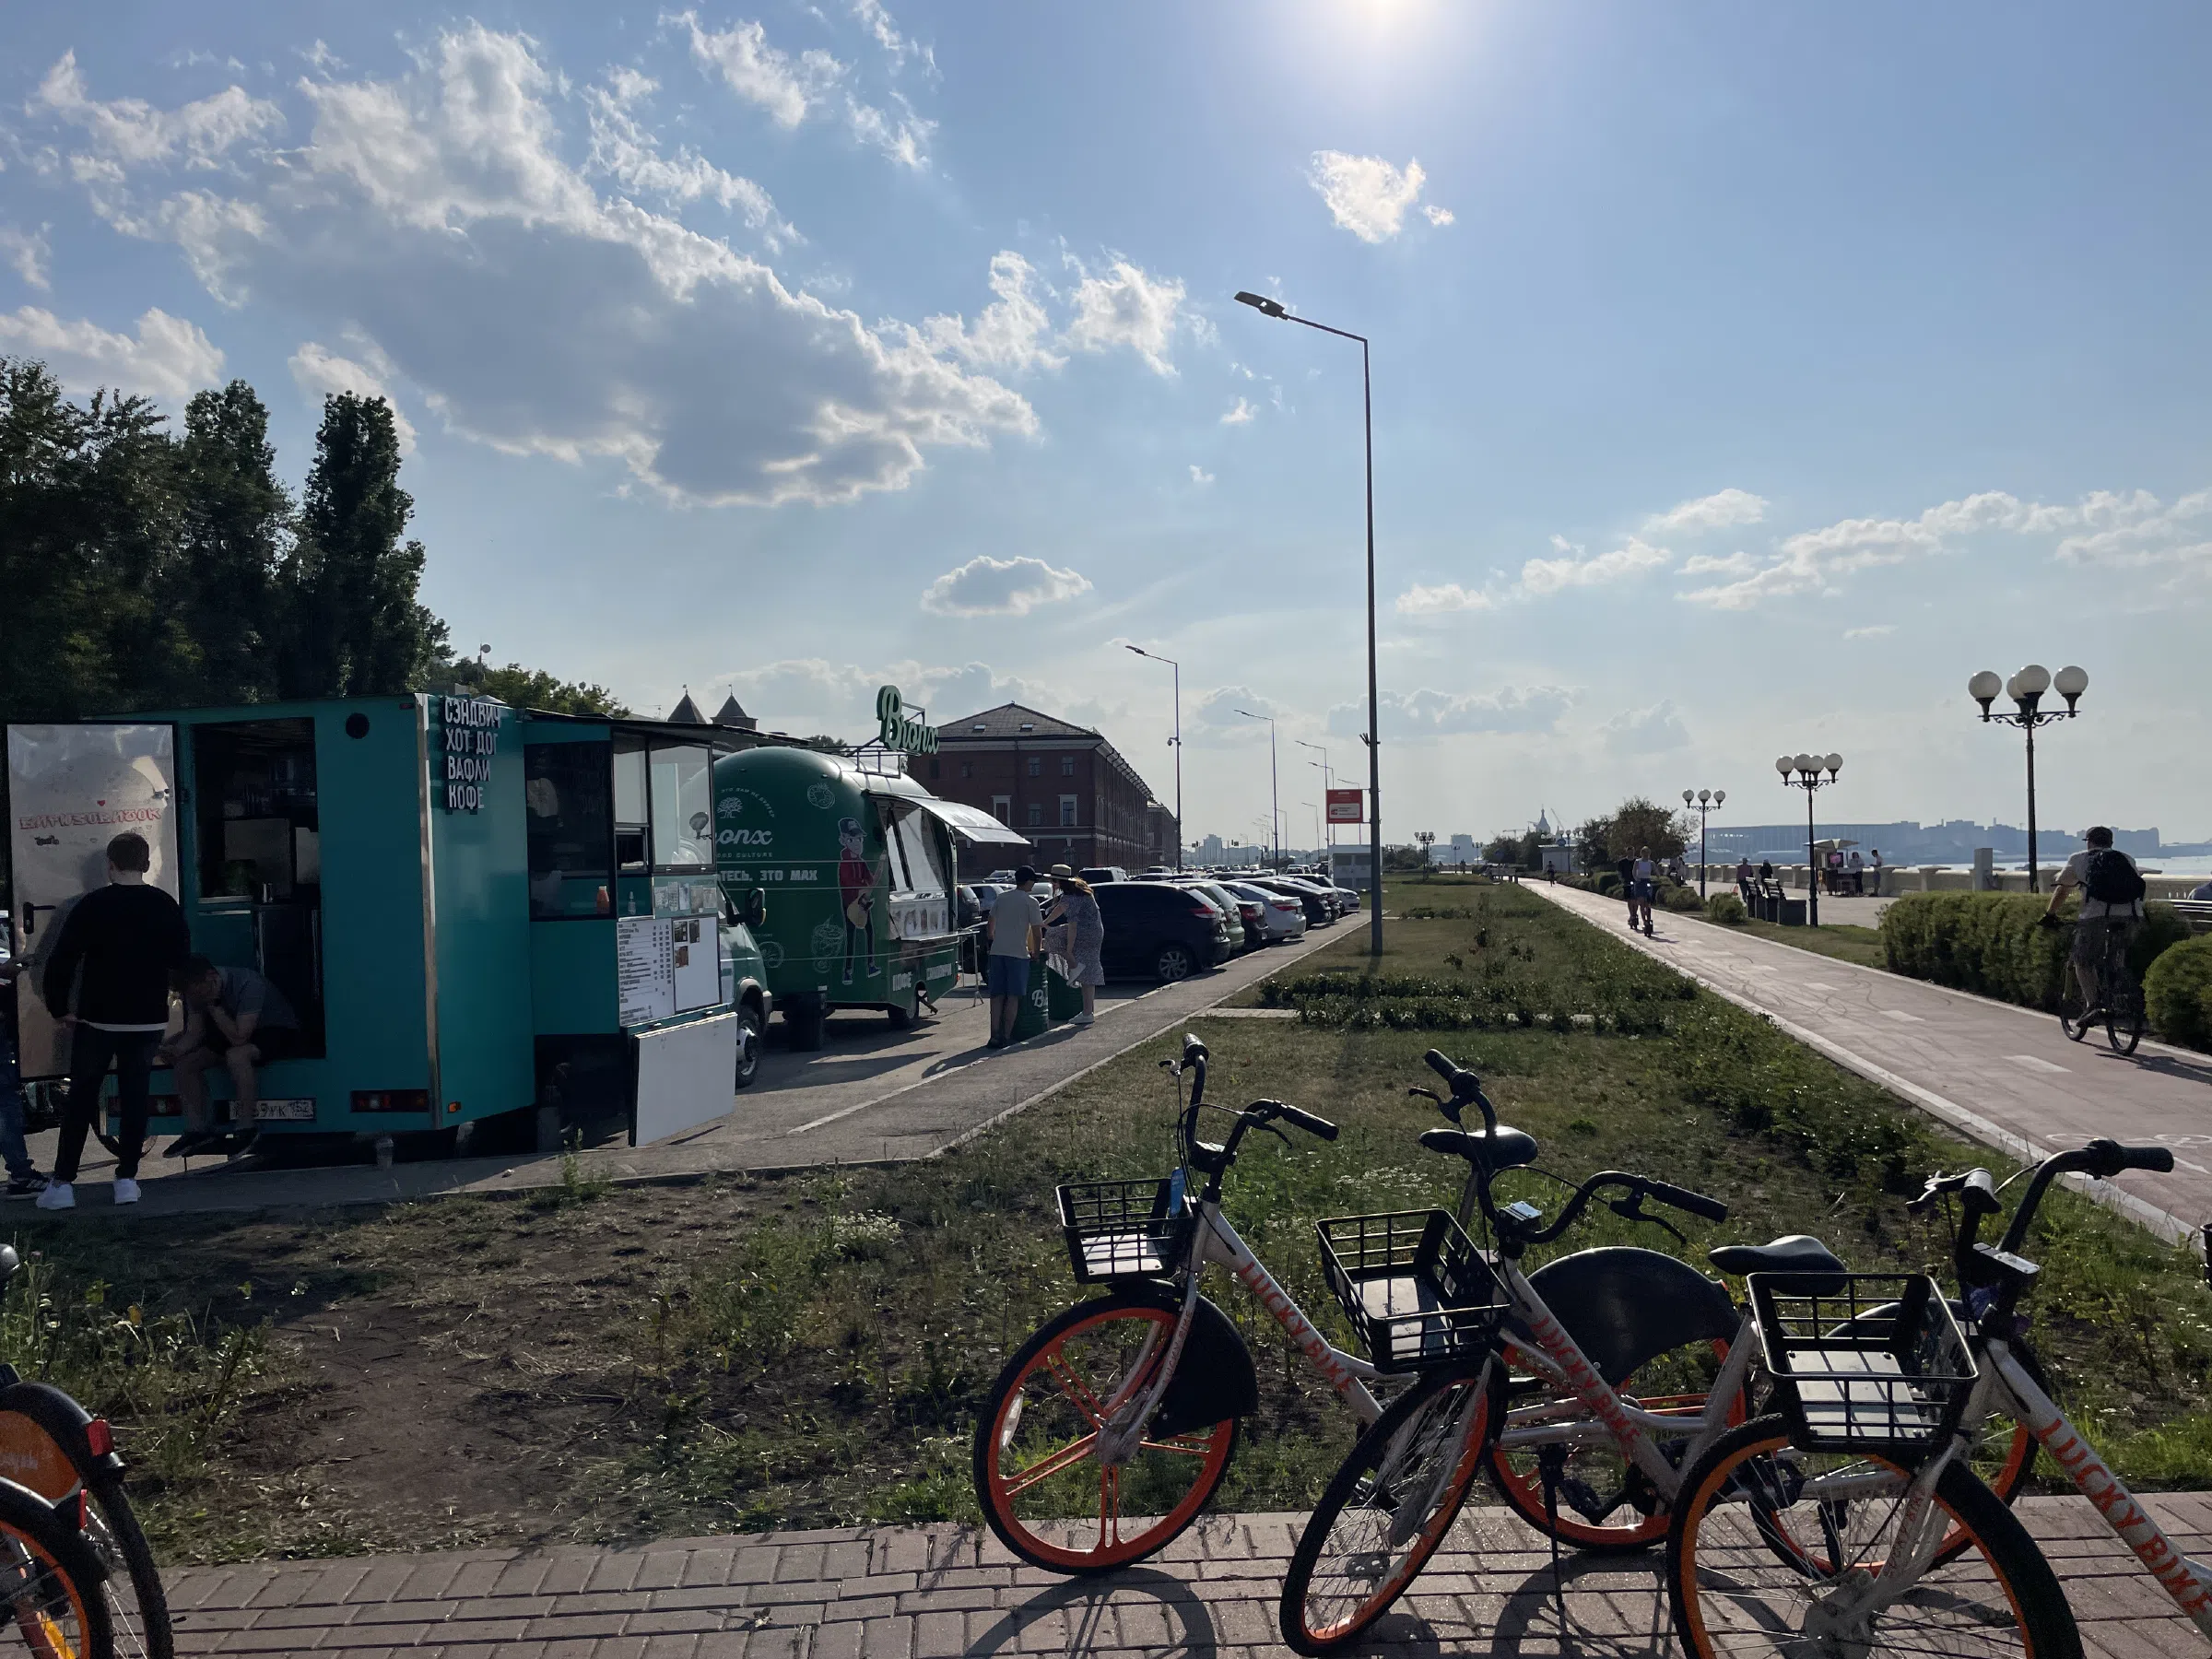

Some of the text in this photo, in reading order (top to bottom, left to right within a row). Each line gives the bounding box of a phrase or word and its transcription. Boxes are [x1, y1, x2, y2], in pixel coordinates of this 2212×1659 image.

[444, 697, 501, 728] СЭНДВИЧ
[877, 685, 939, 754] Bronx
[446, 728, 498, 755] ХОТ ДОГ
[448, 755, 490, 782] ВАФЛИ
[448, 784, 485, 809] КОФЕ
[714, 829, 773, 845] onx
[759, 870, 783, 881] ЭТО
[1238, 1261, 1355, 1394] LUCKY BIKE
[1530, 1314, 1642, 1447] LUCKY BIKE
[2037, 1418, 2147, 1531] LUCKY
